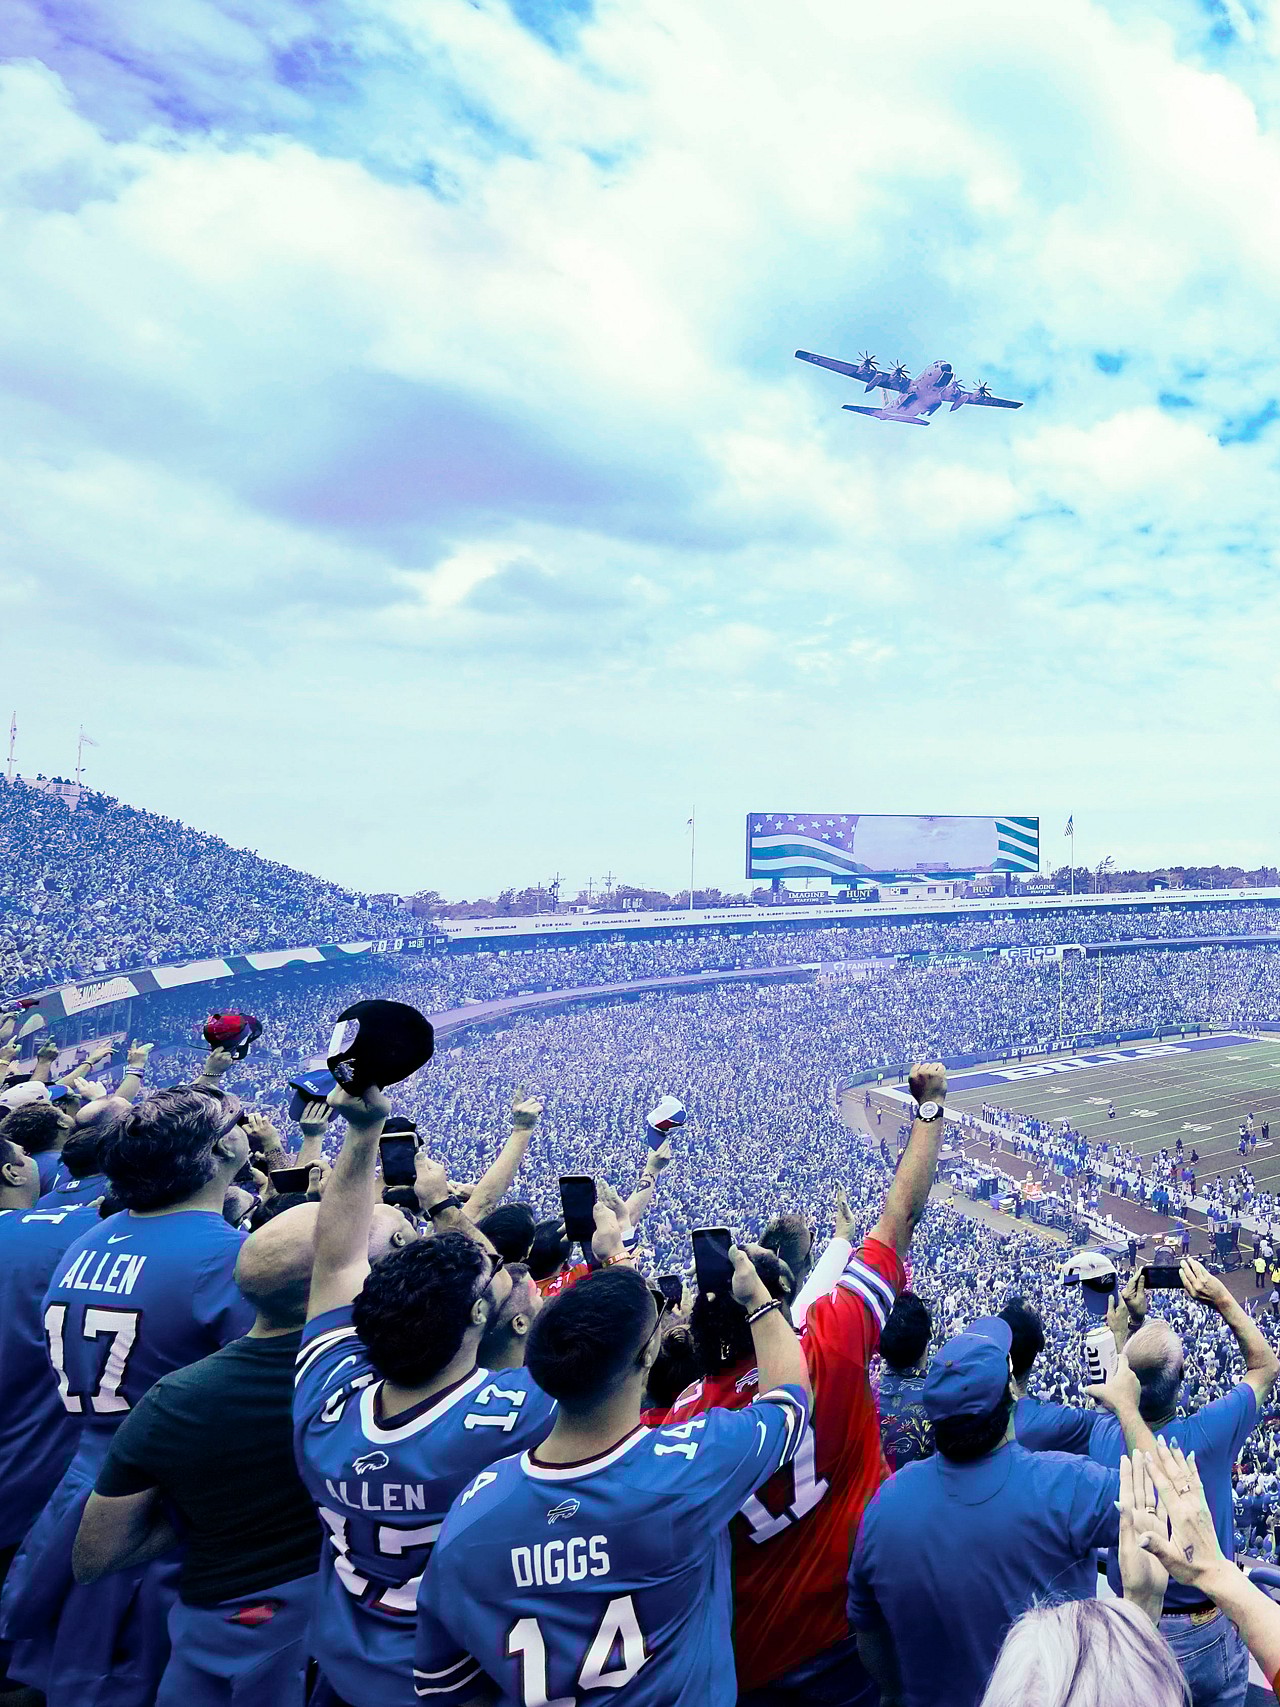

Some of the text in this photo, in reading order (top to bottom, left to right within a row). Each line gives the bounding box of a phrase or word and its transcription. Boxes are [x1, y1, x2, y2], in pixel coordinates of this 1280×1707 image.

[788, 891, 825, 899] IMAGINE
[846, 890, 871, 898] HUNT
[972, 885, 995, 893] HUNT
[846, 961, 886, 971] FANDUEL
[1007, 946, 1057, 960] GEICO
[989, 1045, 1192, 1081] BILLS
[58, 1250, 147, 1295] ALLEN
[43, 1304, 141, 1414] 17
[463, 1383, 527, 1432] 17
[653, 1418, 706, 1460] 14
[510, 1534, 611, 1588] DIGGS
[508, 1594, 654, 1707] 14
